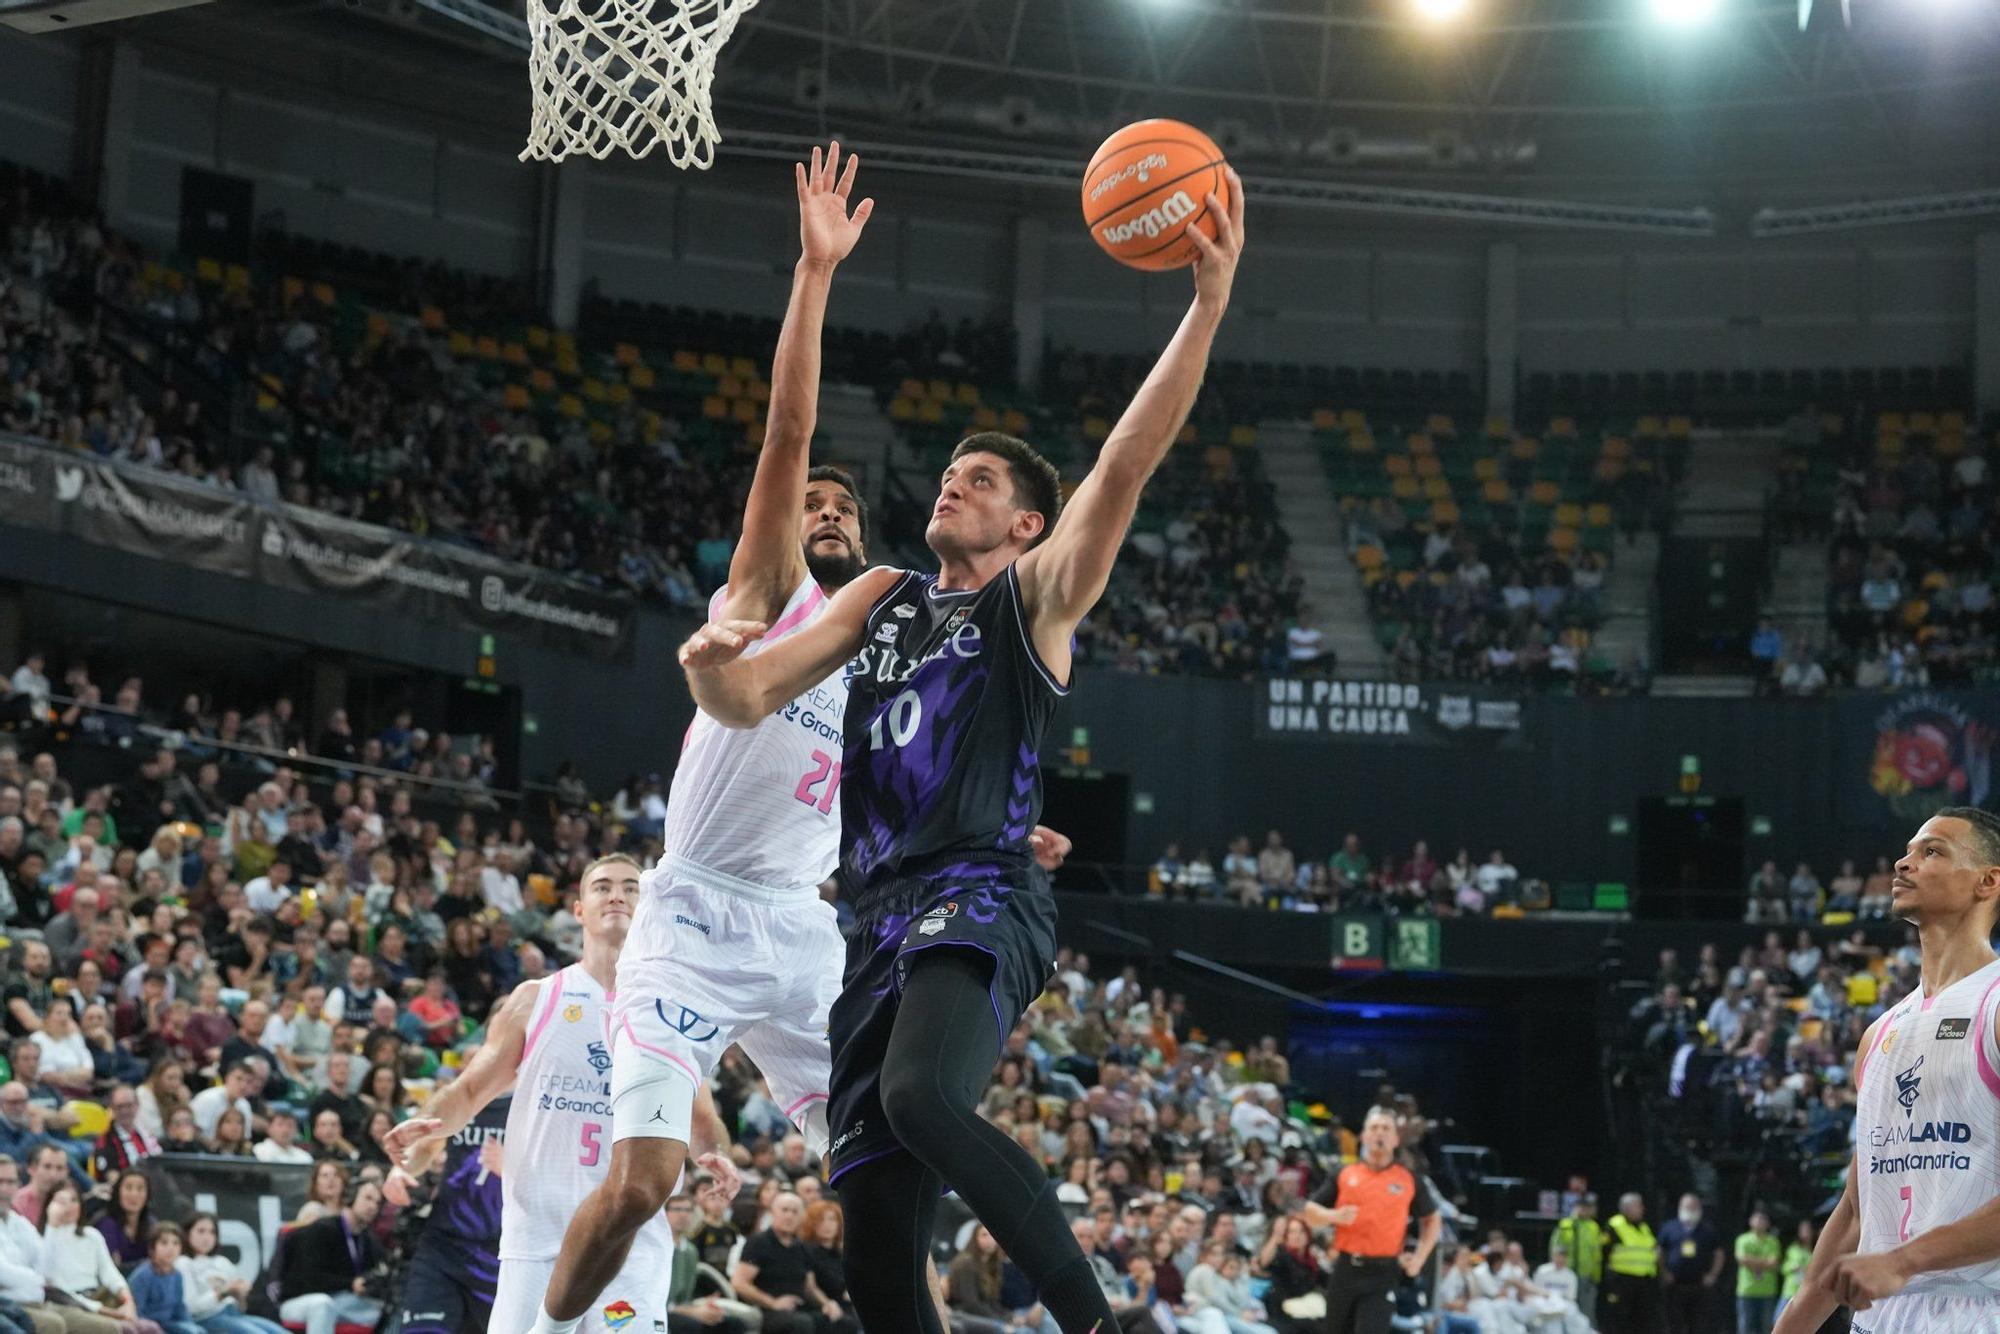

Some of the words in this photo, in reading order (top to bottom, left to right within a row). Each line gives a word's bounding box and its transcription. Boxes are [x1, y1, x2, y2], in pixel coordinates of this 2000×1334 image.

[1102, 190, 1197, 244] Wilson
[1269, 679, 1303, 703] UN
[870, 689, 922, 751] 10
[1268, 706, 1319, 731] UNA
[1329, 707, 1410, 734] CAUSA
[794, 748, 843, 816] 21
[676, 914, 711, 936] SPALDING
[1344, 922, 1370, 956] B
[579, 1122, 602, 1167] 5
